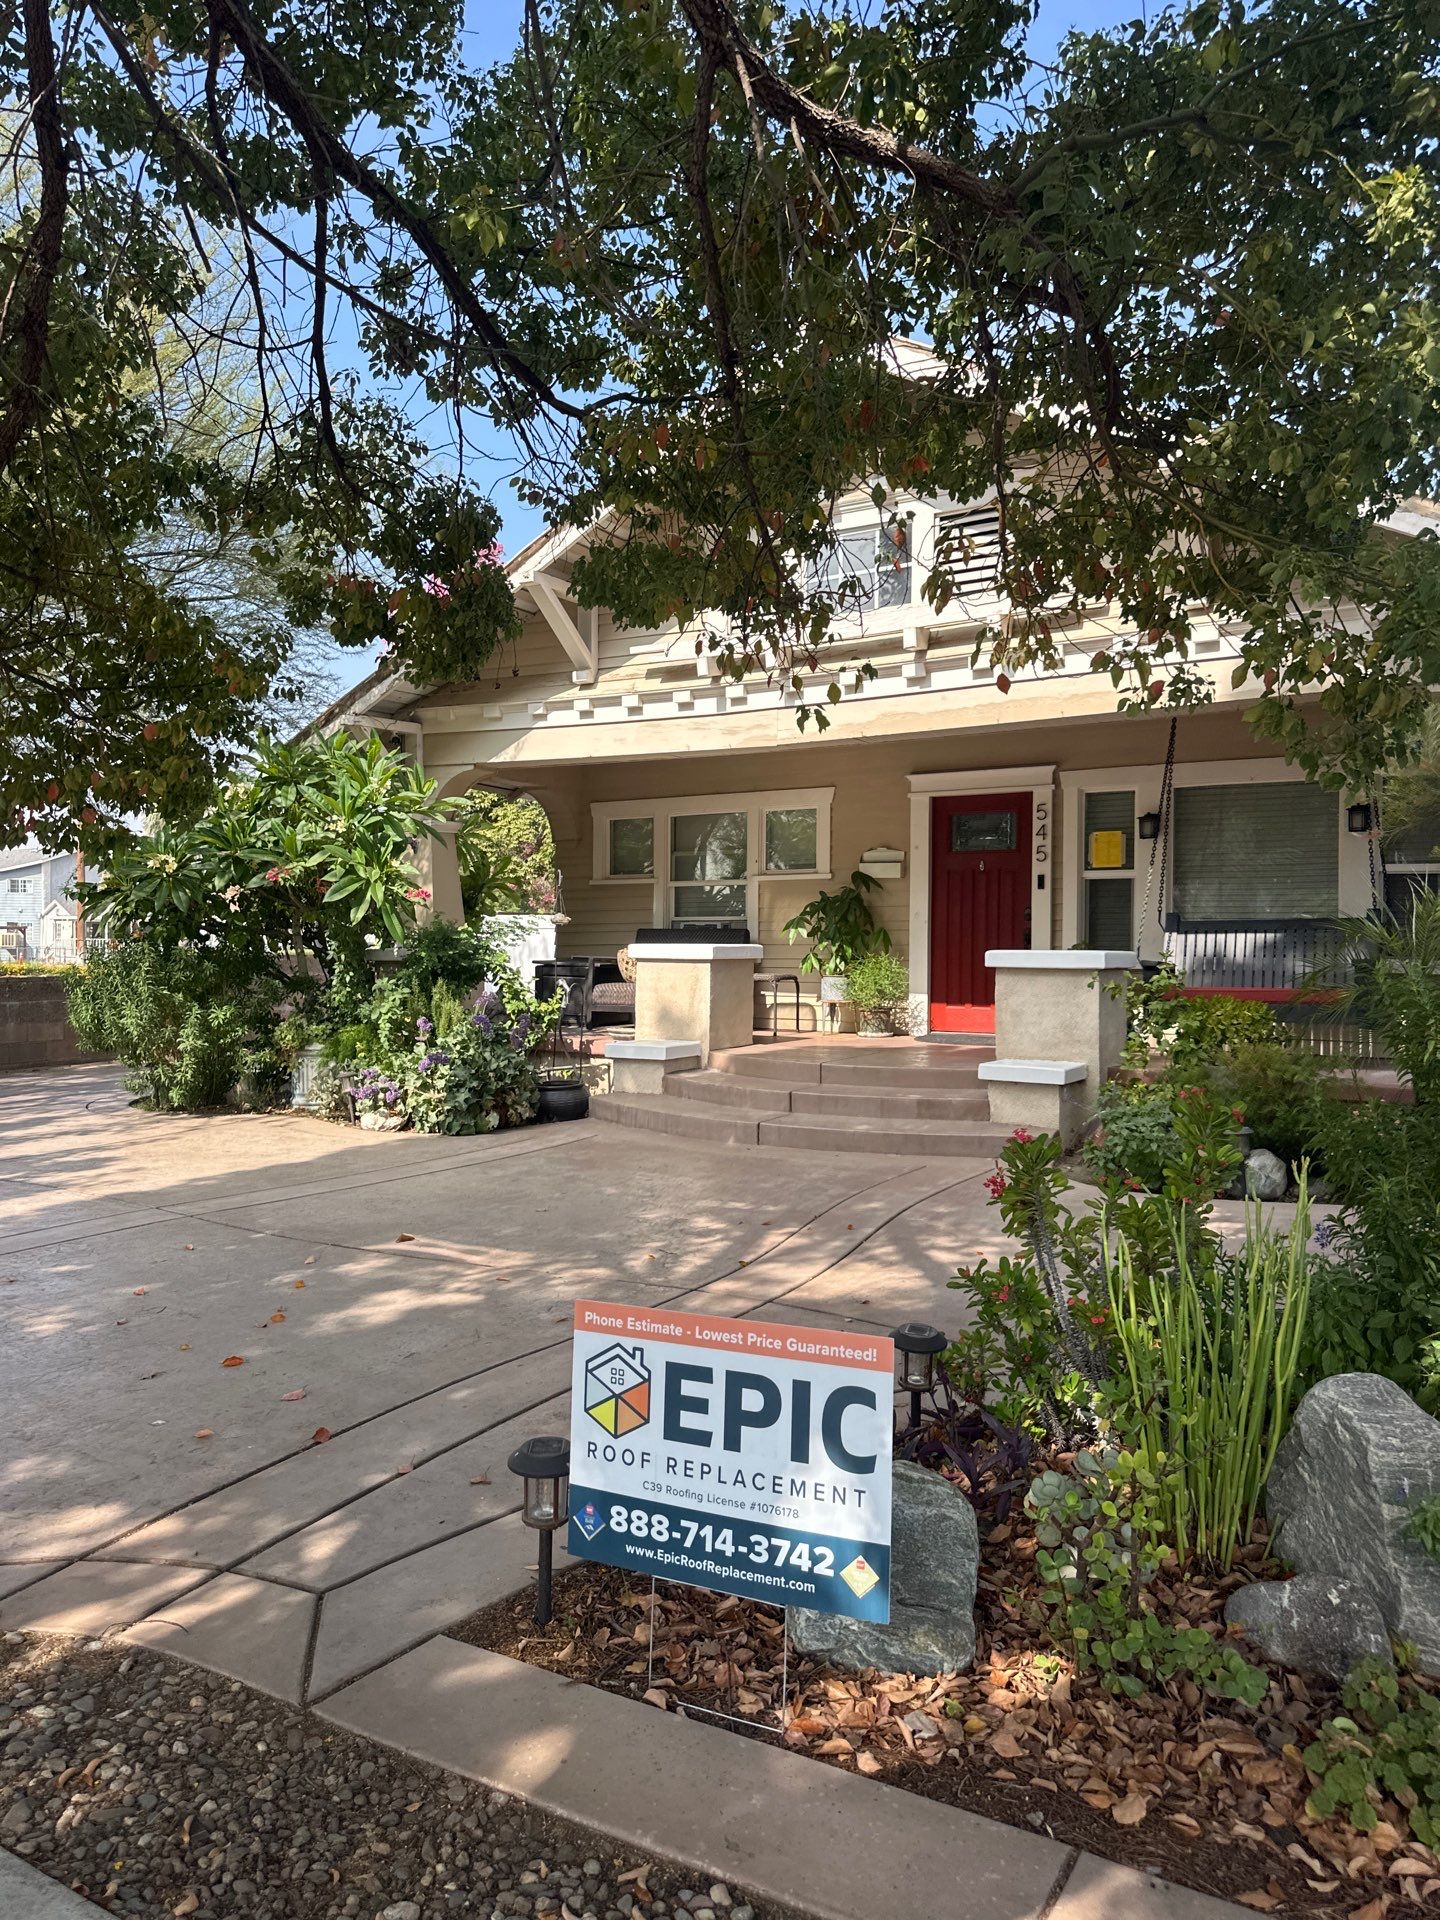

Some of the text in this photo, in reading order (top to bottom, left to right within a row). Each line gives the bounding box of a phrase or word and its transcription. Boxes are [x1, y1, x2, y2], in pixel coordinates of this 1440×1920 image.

[1035, 803, 1048, 862] 545
[584, 1311, 624, 1329] Phone
[627, 1317, 683, 1336] Estimate
[695, 1326, 743, 1345] Lowest
[747, 1333, 782, 1350] Price
[787, 1338, 877, 1362] Guaranteed!
[663, 1361, 877, 1474] EPIC
[587, 1441, 866, 1508] ROOF REPLACEMENT
[642, 1480, 799, 1519] C39 Roofing License #1076178
[609, 1505, 835, 1577] 888-714-3742
[625, 1543, 816, 1594] www.EpicRoofReplacement.com
